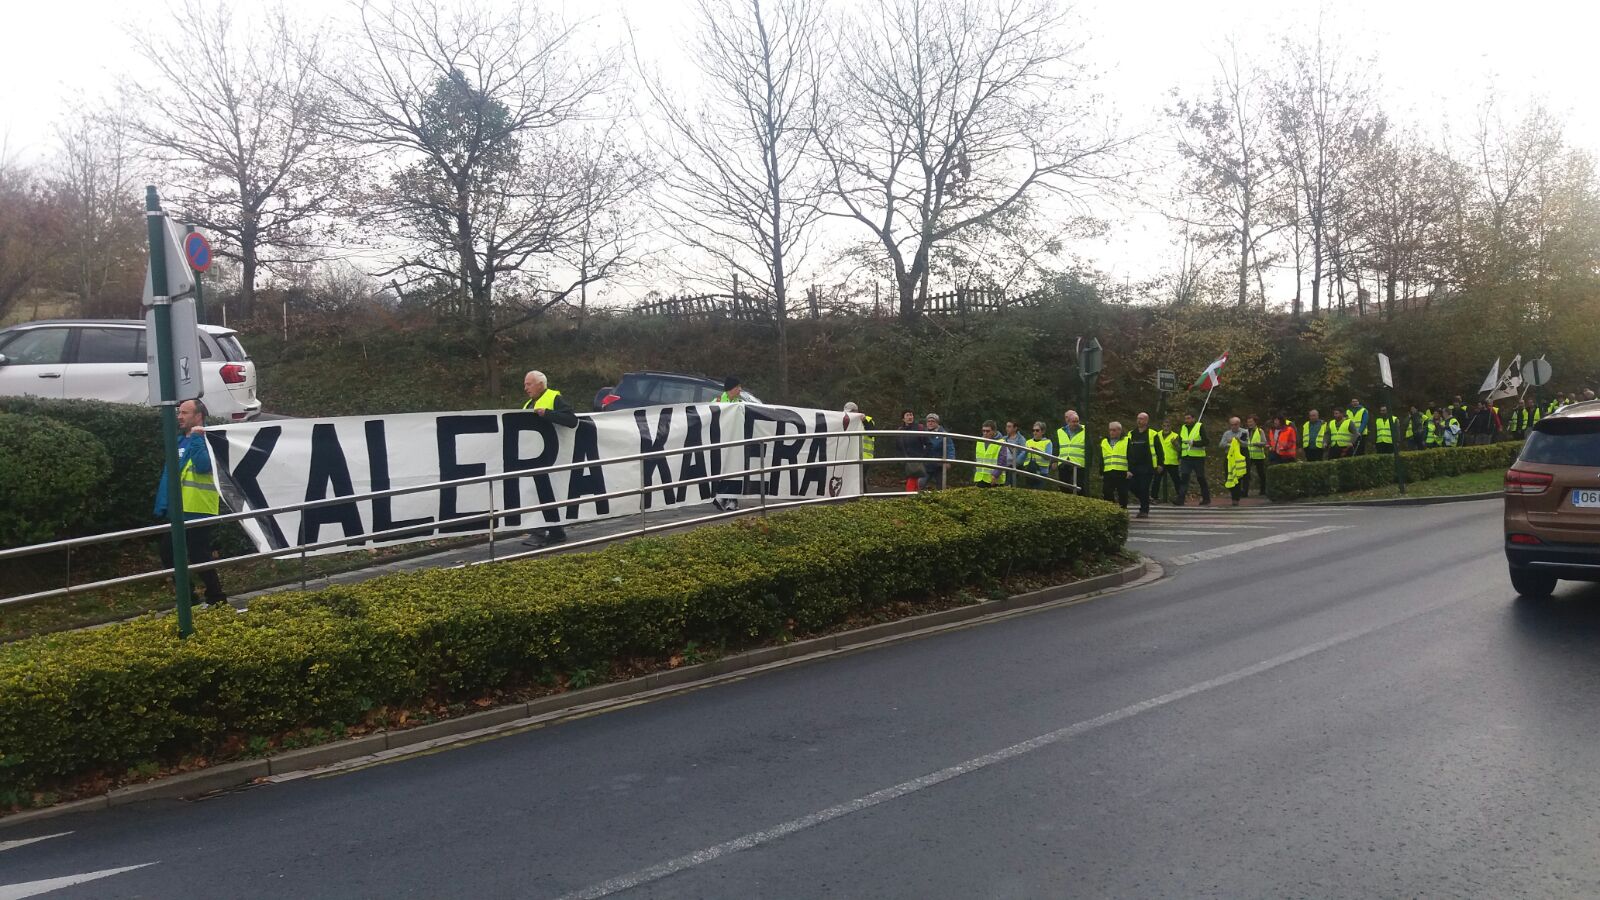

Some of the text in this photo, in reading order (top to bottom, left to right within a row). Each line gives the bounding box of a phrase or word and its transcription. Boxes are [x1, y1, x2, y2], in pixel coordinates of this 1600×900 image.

[205, 404, 828, 548] KALERA KALERA
[1580, 492, 1600, 503] 06
